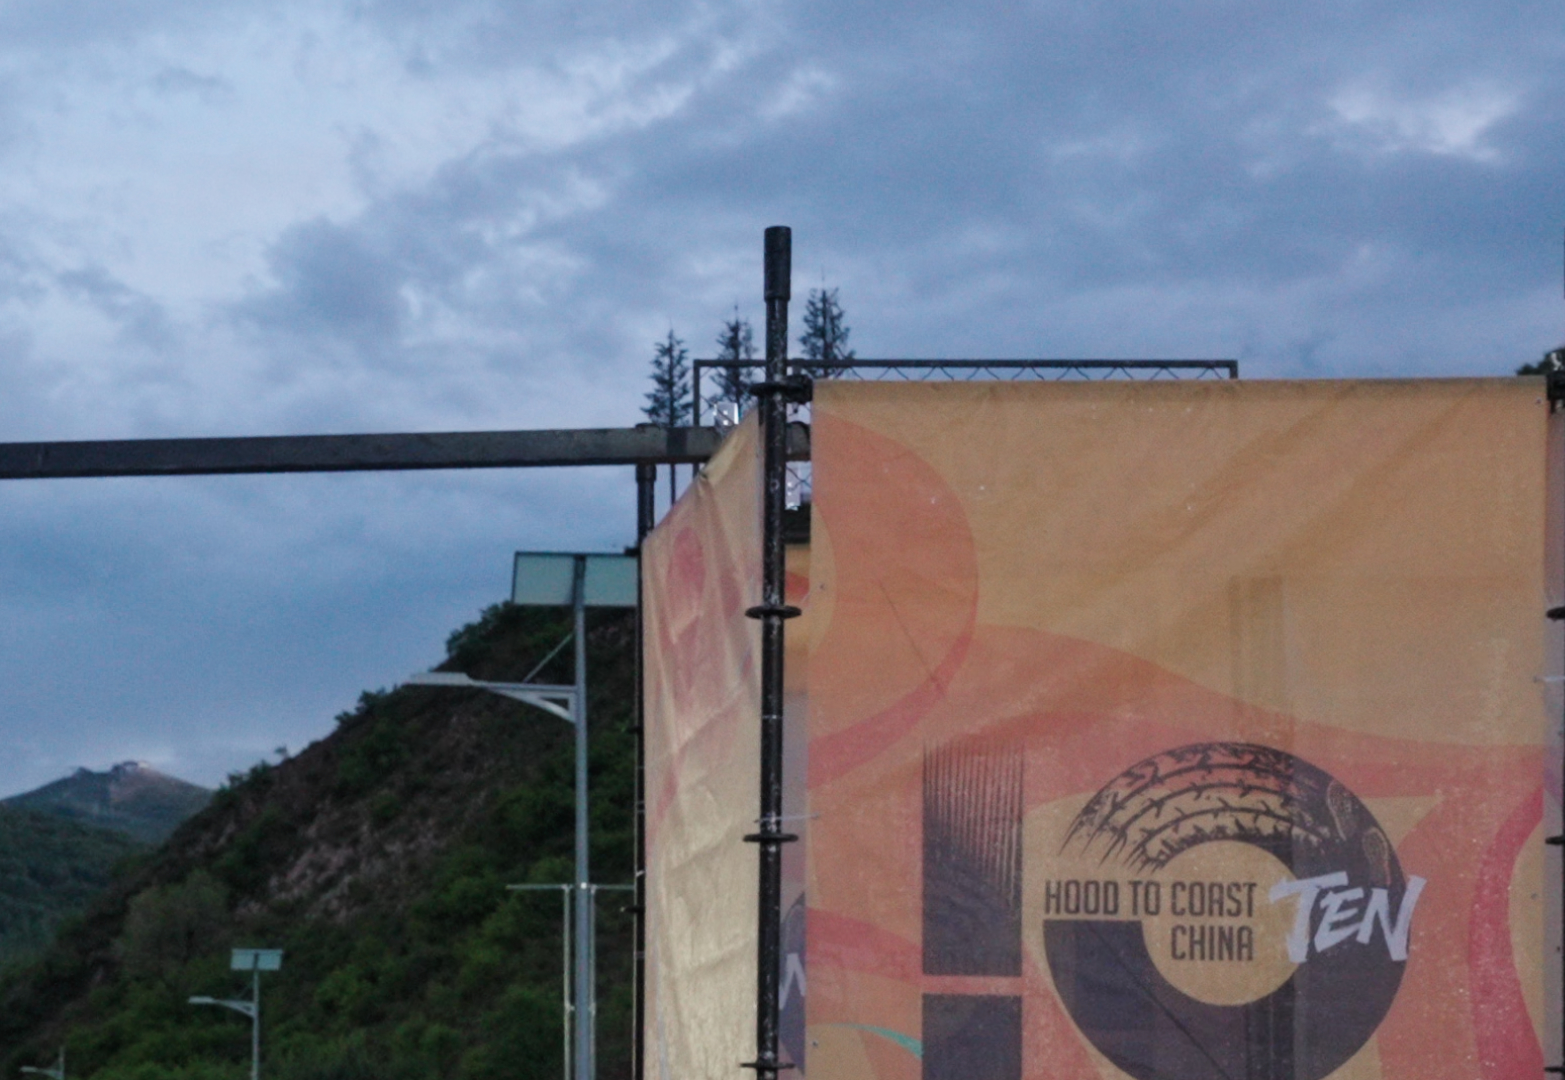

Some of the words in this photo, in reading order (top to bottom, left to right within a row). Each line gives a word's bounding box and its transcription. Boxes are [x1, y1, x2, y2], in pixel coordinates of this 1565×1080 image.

[1044, 880, 1119, 916] HOOD
[1129, 881, 1161, 916] TO
[1170, 881, 1258, 917] COAST
[1269, 871, 1427, 963] TEN
[1171, 925, 1255, 961] CHINA
